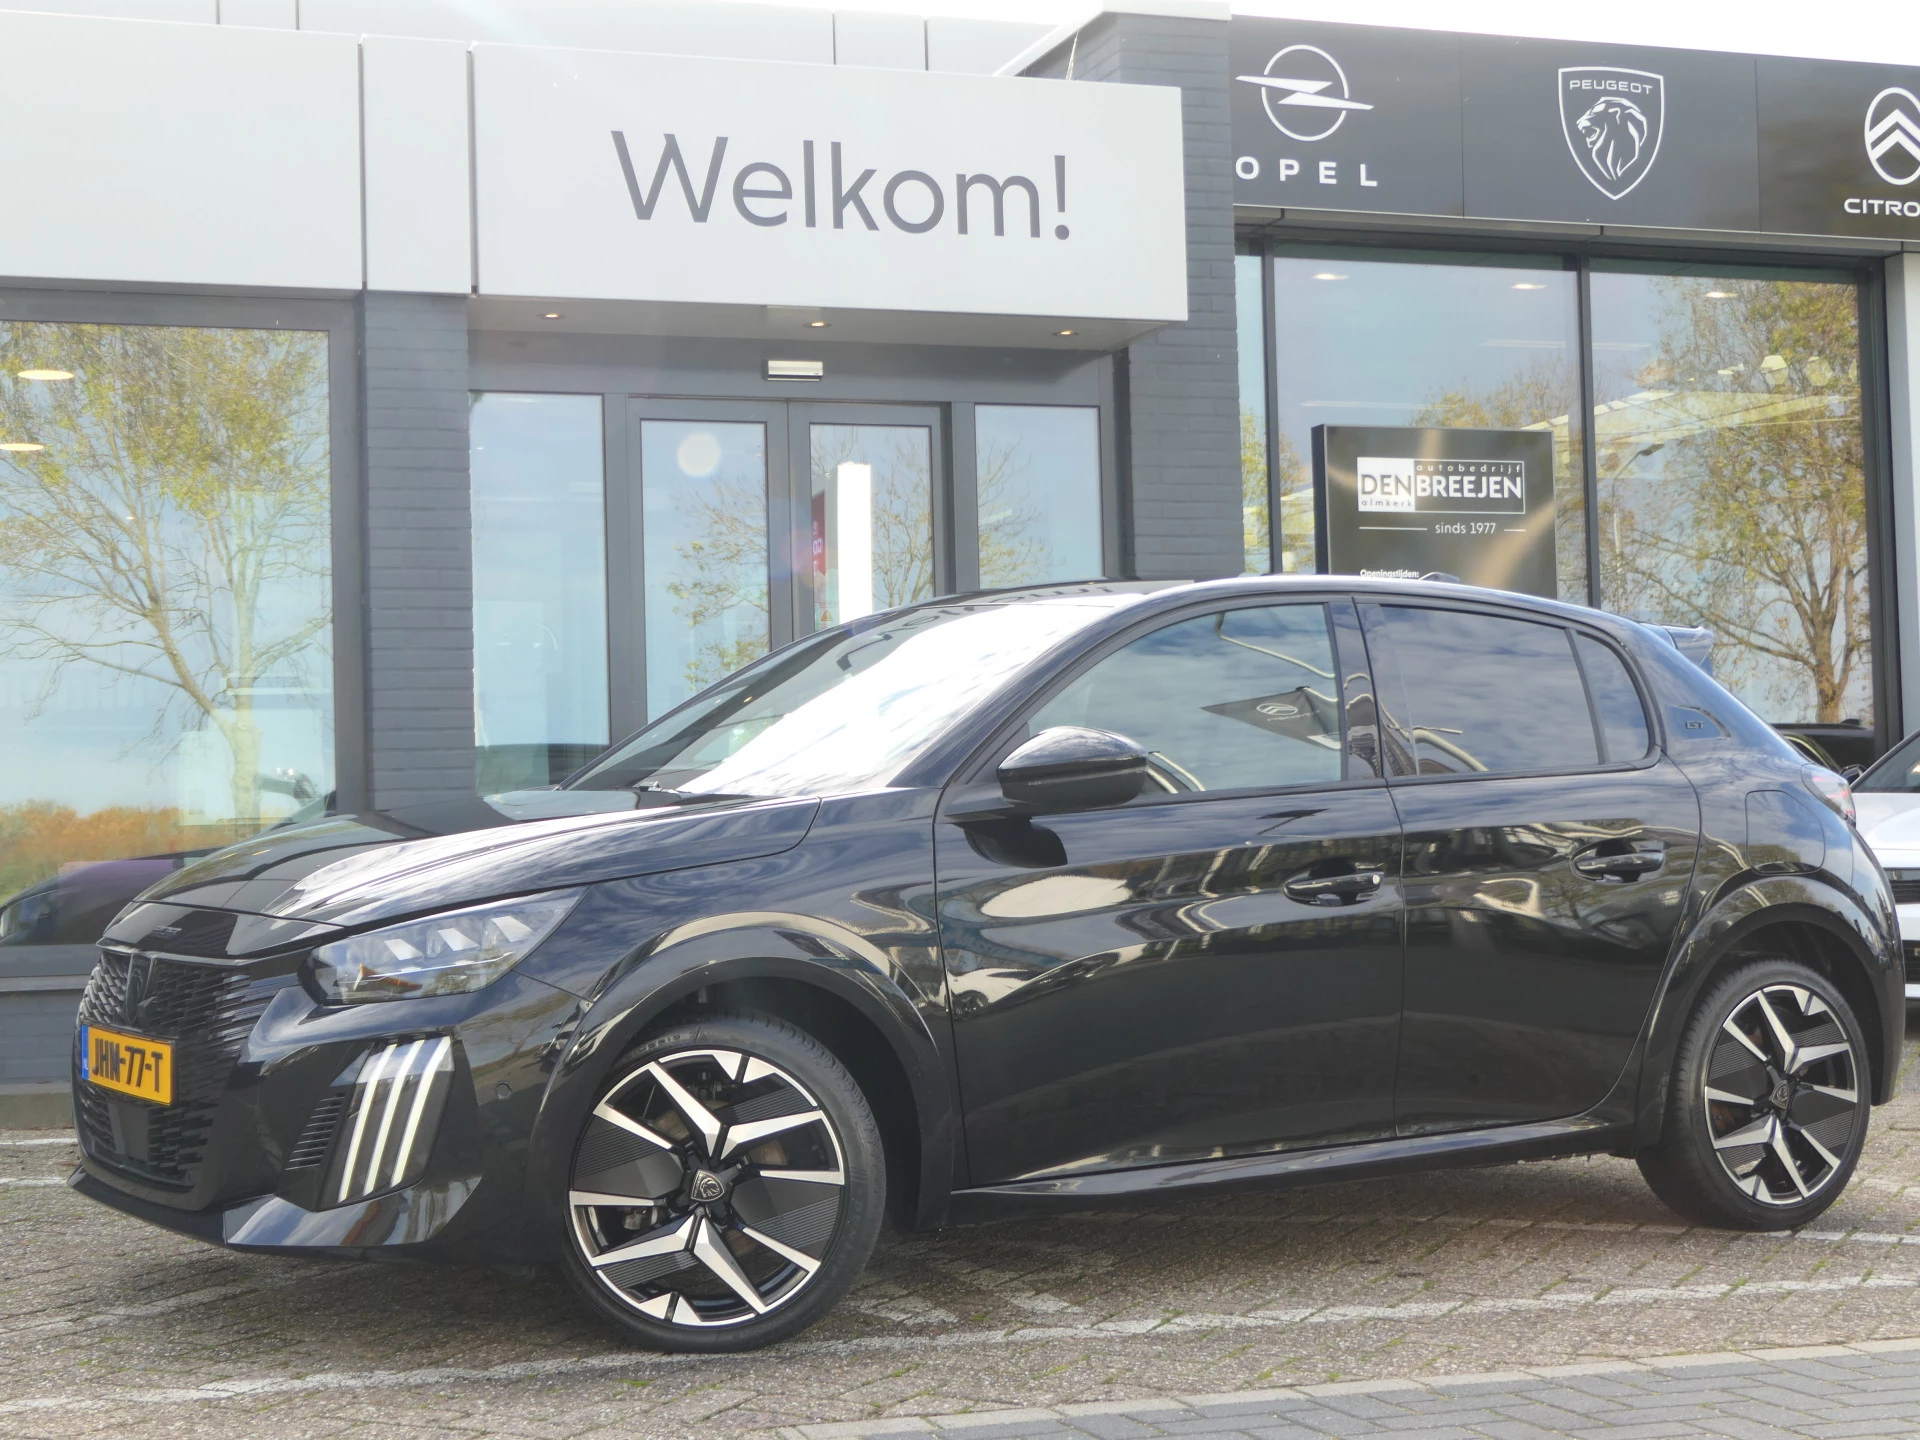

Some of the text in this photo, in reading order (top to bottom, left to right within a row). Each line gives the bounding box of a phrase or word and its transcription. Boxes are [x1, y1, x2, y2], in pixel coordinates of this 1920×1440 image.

[1570, 78, 1653, 95] PEUGEOT
[1235, 155, 1378, 187] OPEL
[610, 130, 1070, 241] Welkom!
[1416, 463, 1521, 474] autobedrijf
[1361, 499, 1412, 507] almkerk
[1435, 522, 1497, 535] sinds 1977
[92, 1037, 164, 1093] JHN-77-T
